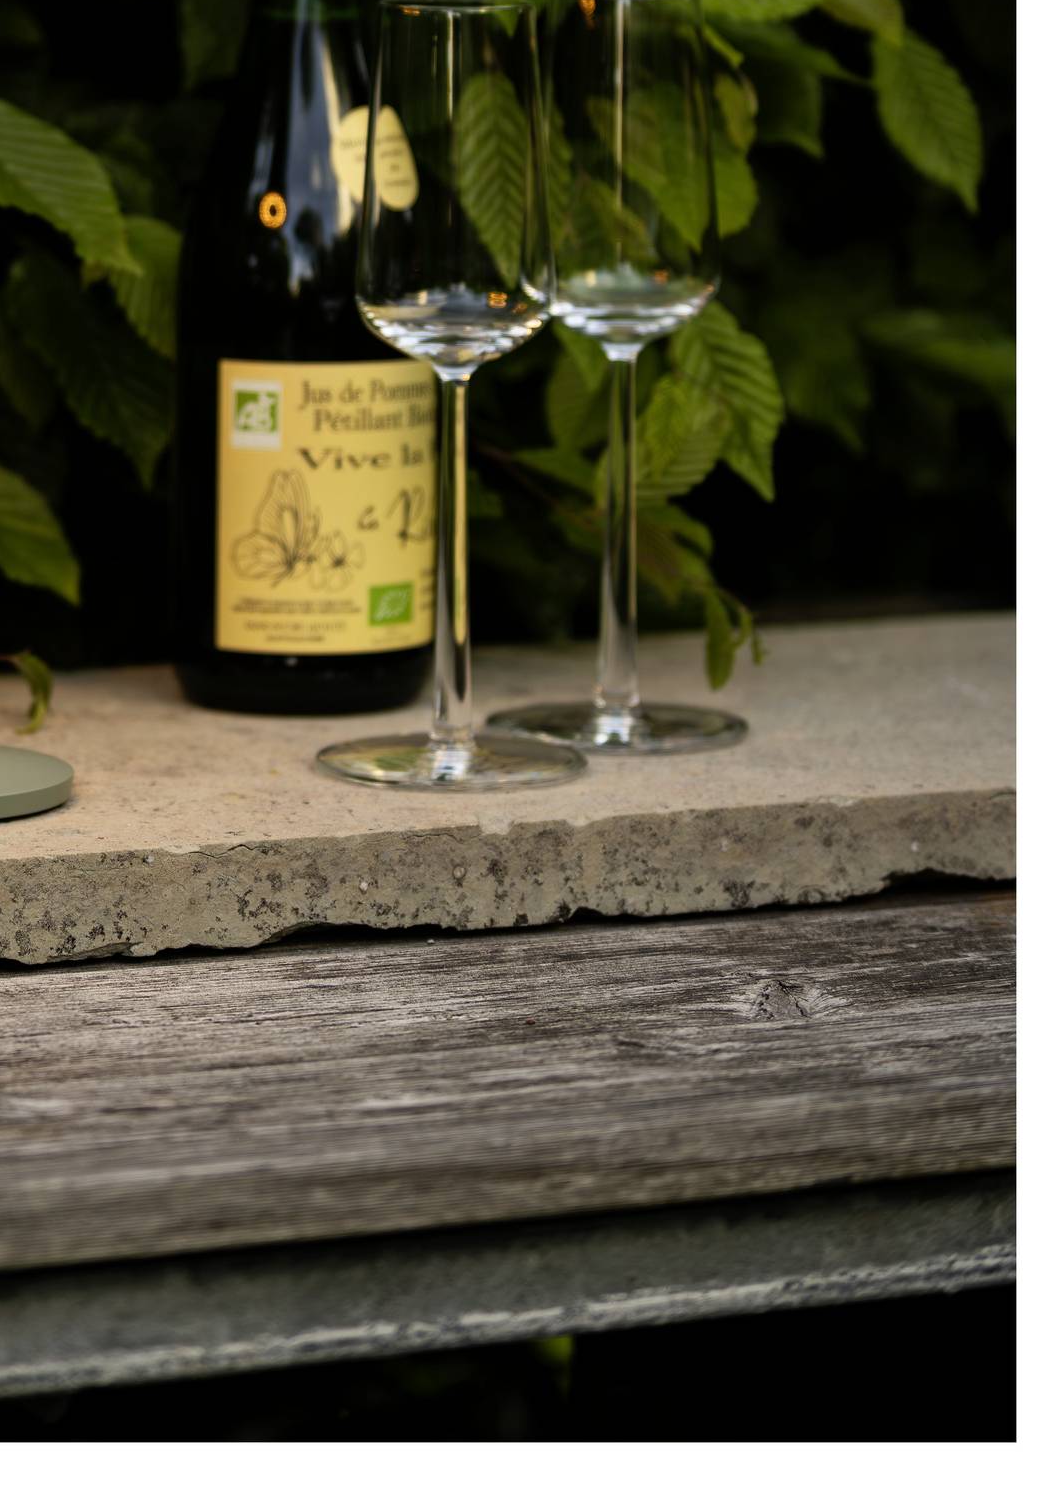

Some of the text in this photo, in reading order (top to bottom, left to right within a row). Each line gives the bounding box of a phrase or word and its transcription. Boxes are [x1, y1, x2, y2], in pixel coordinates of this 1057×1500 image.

[298, 379, 332, 410] Jus
[339, 379, 363, 403] de
[297, 443, 424, 469] Vive la
